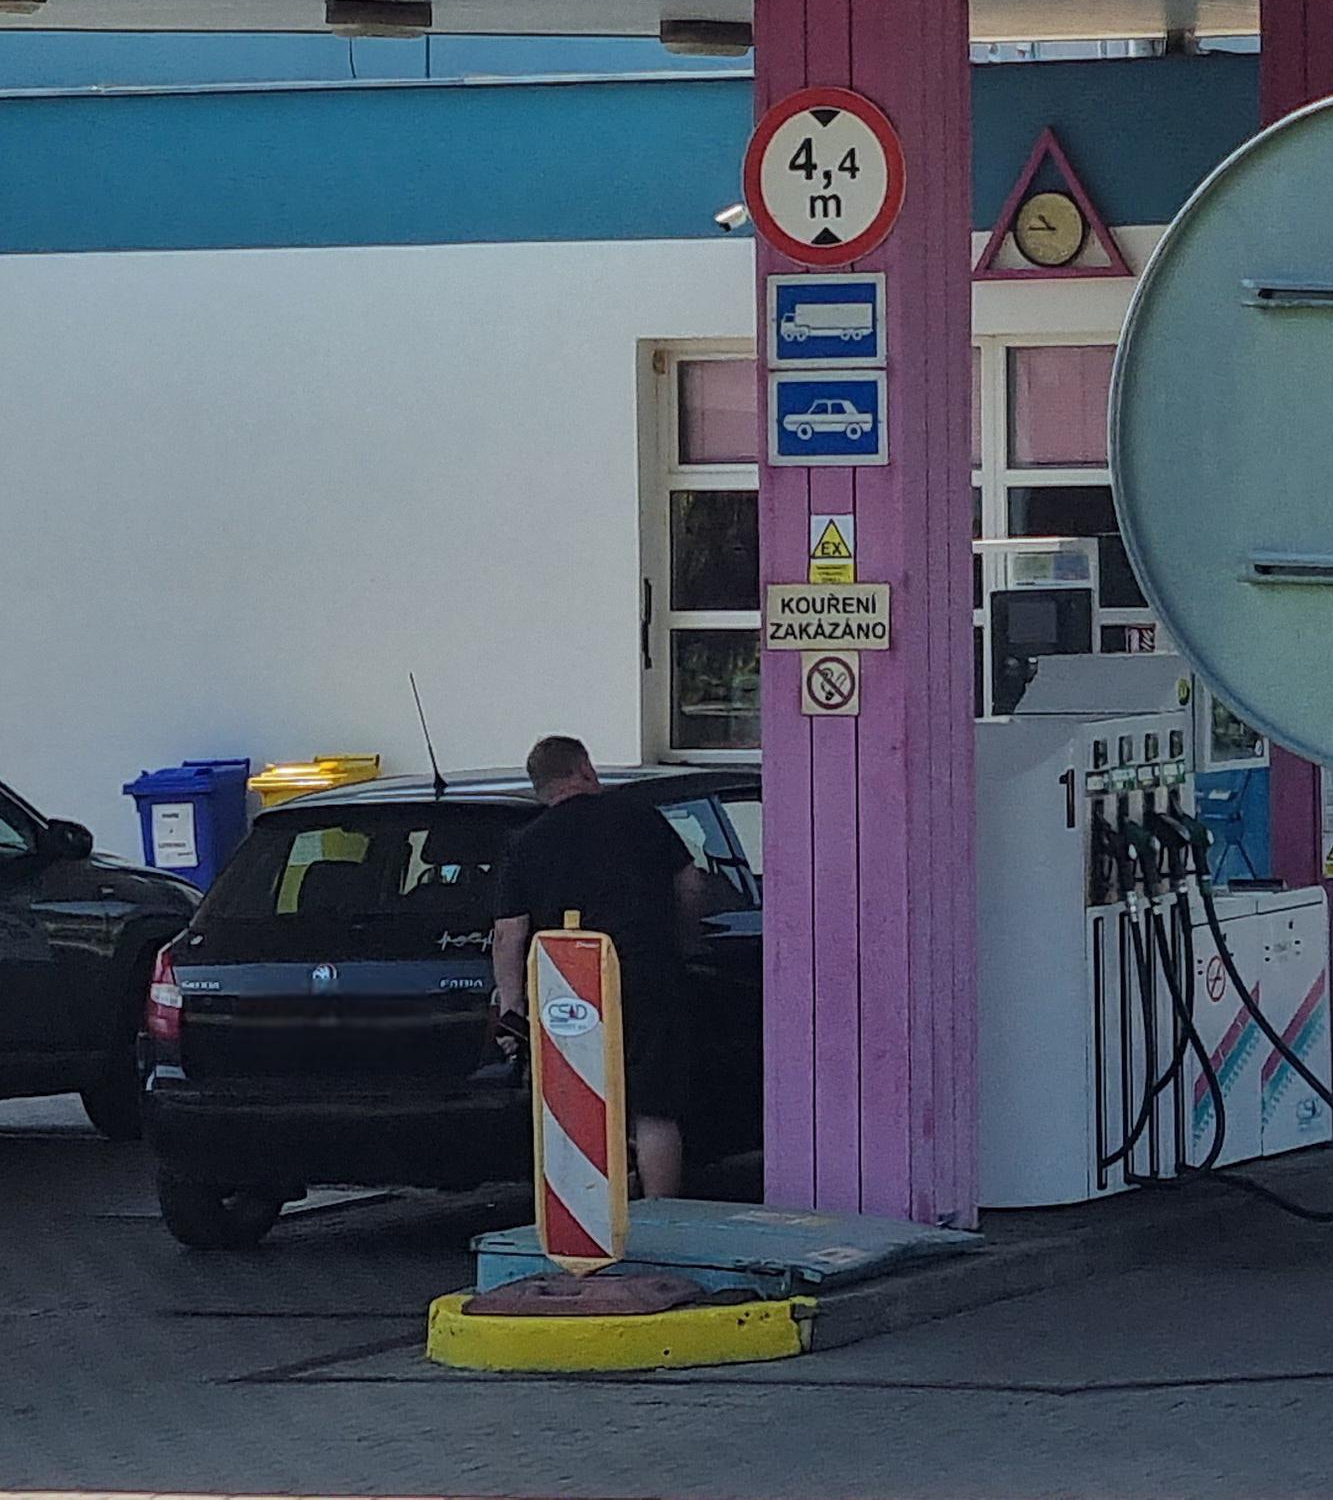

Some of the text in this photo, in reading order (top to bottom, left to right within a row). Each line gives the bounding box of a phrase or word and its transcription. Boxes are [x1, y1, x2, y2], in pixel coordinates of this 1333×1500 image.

[789, 137, 860, 190] 4,4
[810, 194, 842, 218] m
[821, 541, 842, 556] EX
[781, 592, 877, 615] KOUŘENÍ
[769, 617, 886, 640] ZAKÁZÁNO
[1059, 769, 1075, 828] 1
